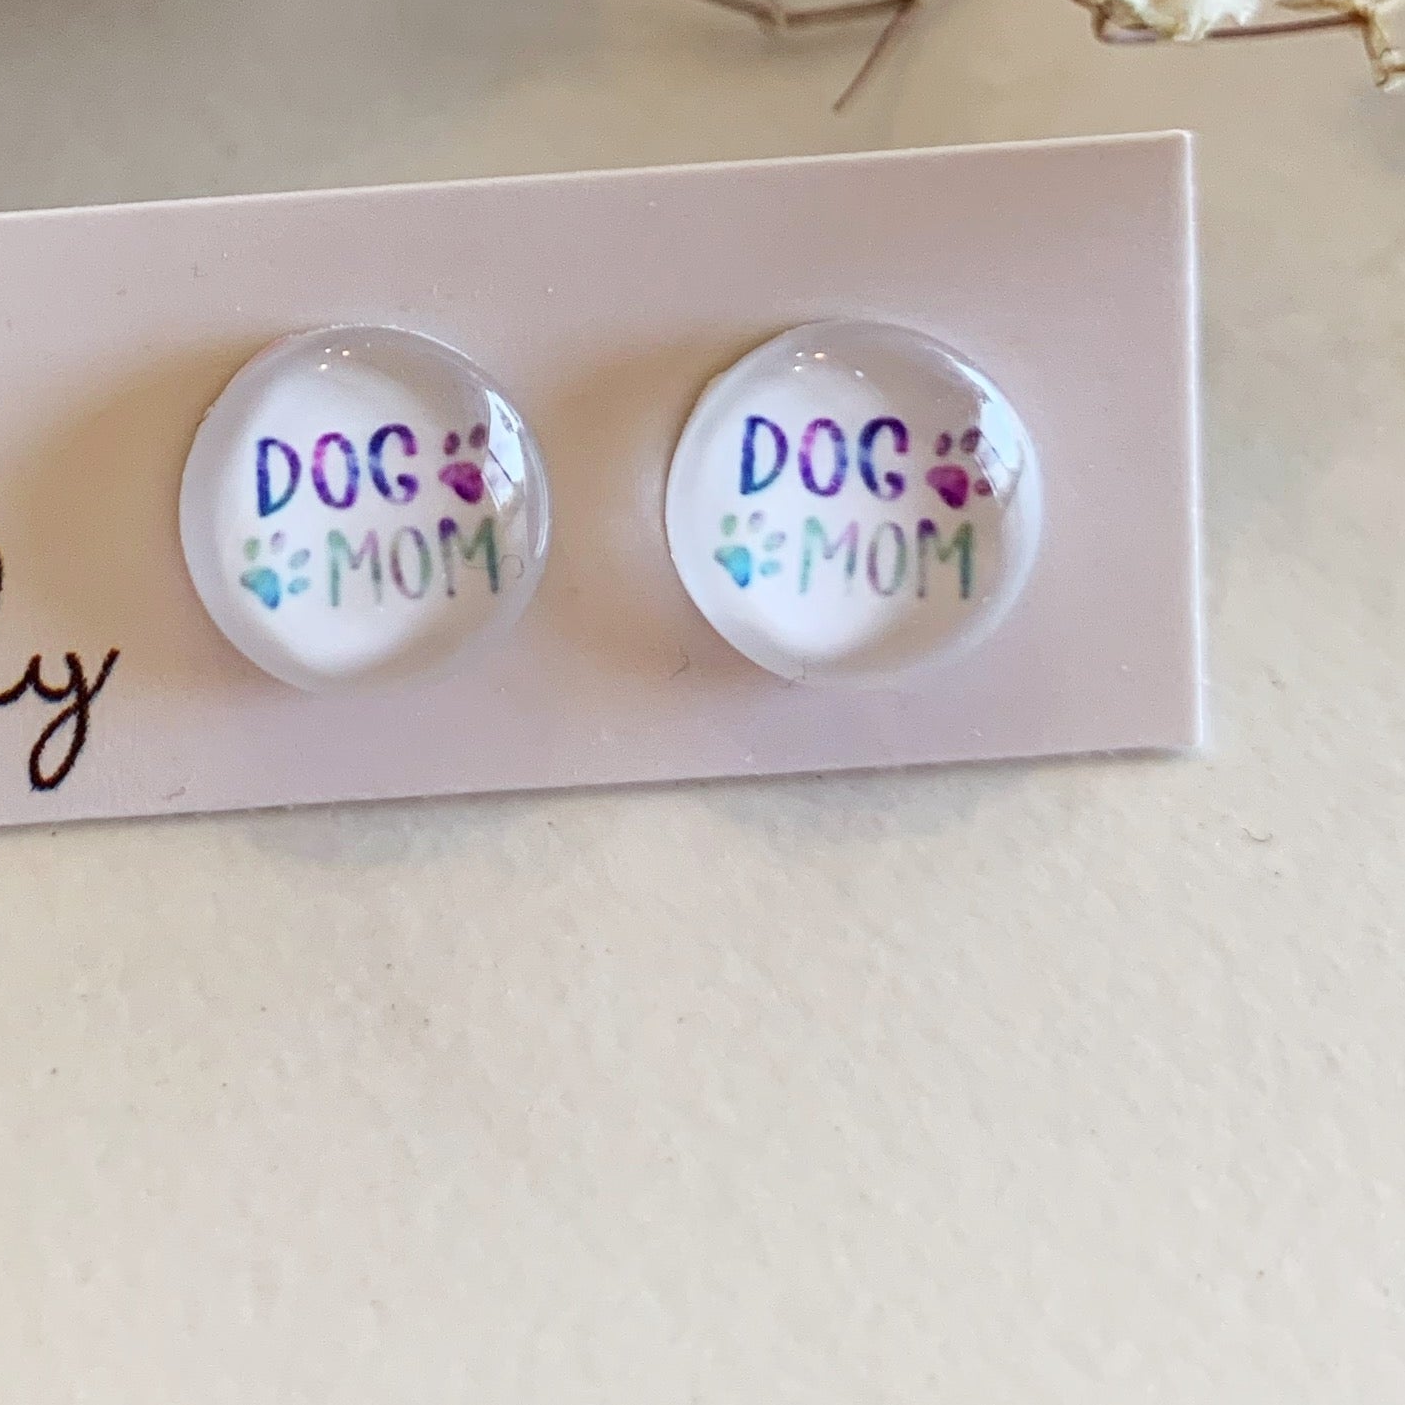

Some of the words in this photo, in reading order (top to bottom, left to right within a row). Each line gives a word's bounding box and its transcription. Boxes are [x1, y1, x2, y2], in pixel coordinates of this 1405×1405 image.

[255, 421, 419, 518] DOG
[739, 413, 909, 499] DOG
[326, 515, 503, 608] MOM
[798, 516, 976, 601] MOM
